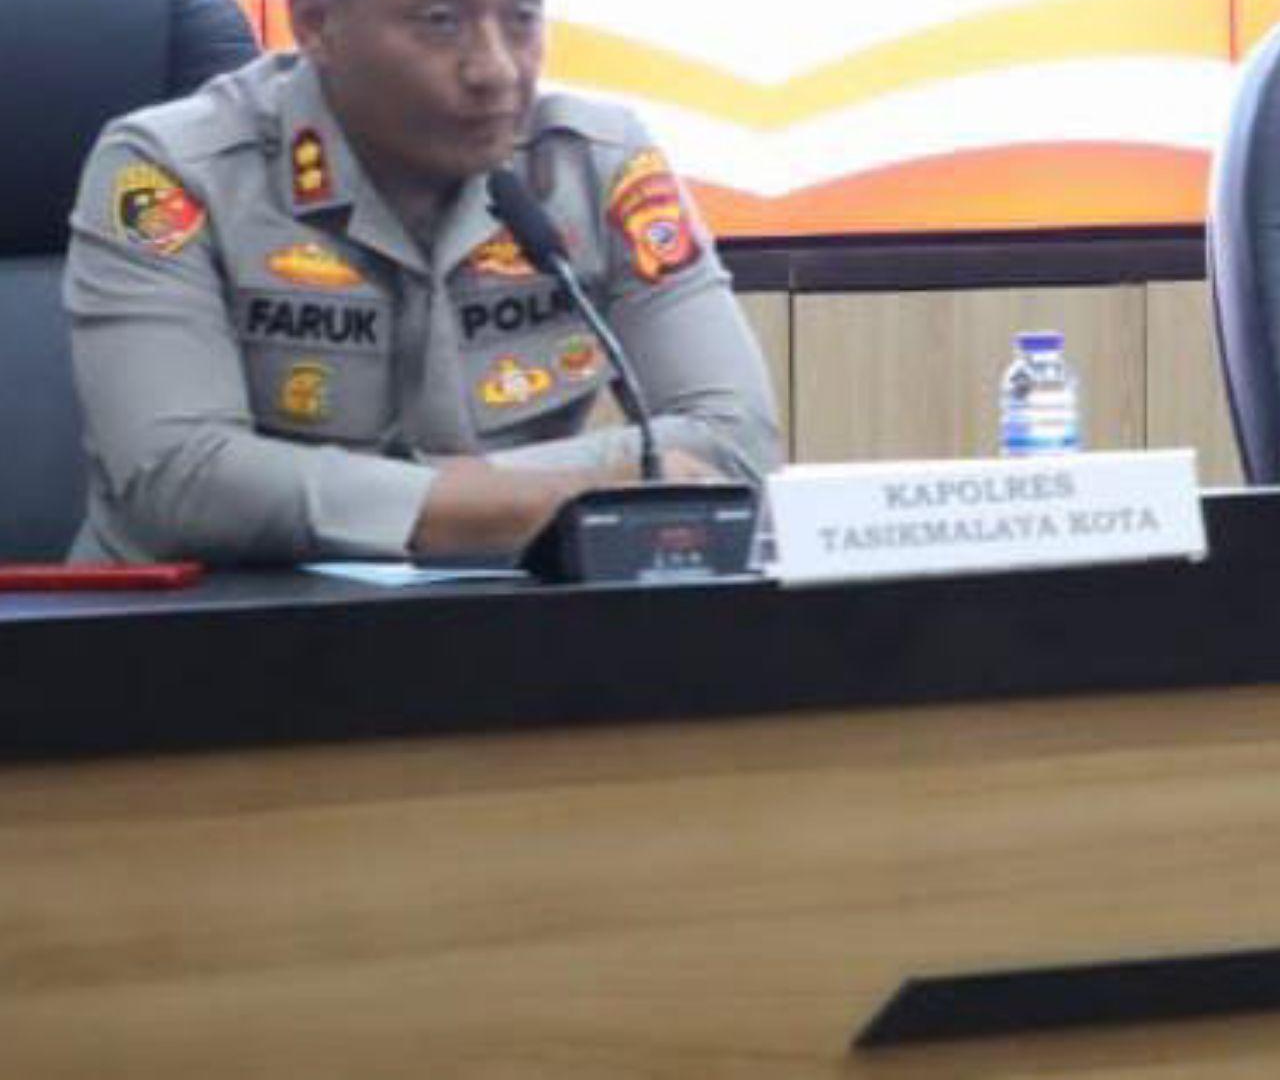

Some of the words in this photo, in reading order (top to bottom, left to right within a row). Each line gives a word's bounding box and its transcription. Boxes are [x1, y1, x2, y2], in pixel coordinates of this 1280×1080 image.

[248, 297, 378, 345] FARUK
[882, 472, 1074, 510] KAPOLRES
[817, 514, 1062, 553] TASIKMALAYA
[1066, 506, 1162, 537] KOTA
